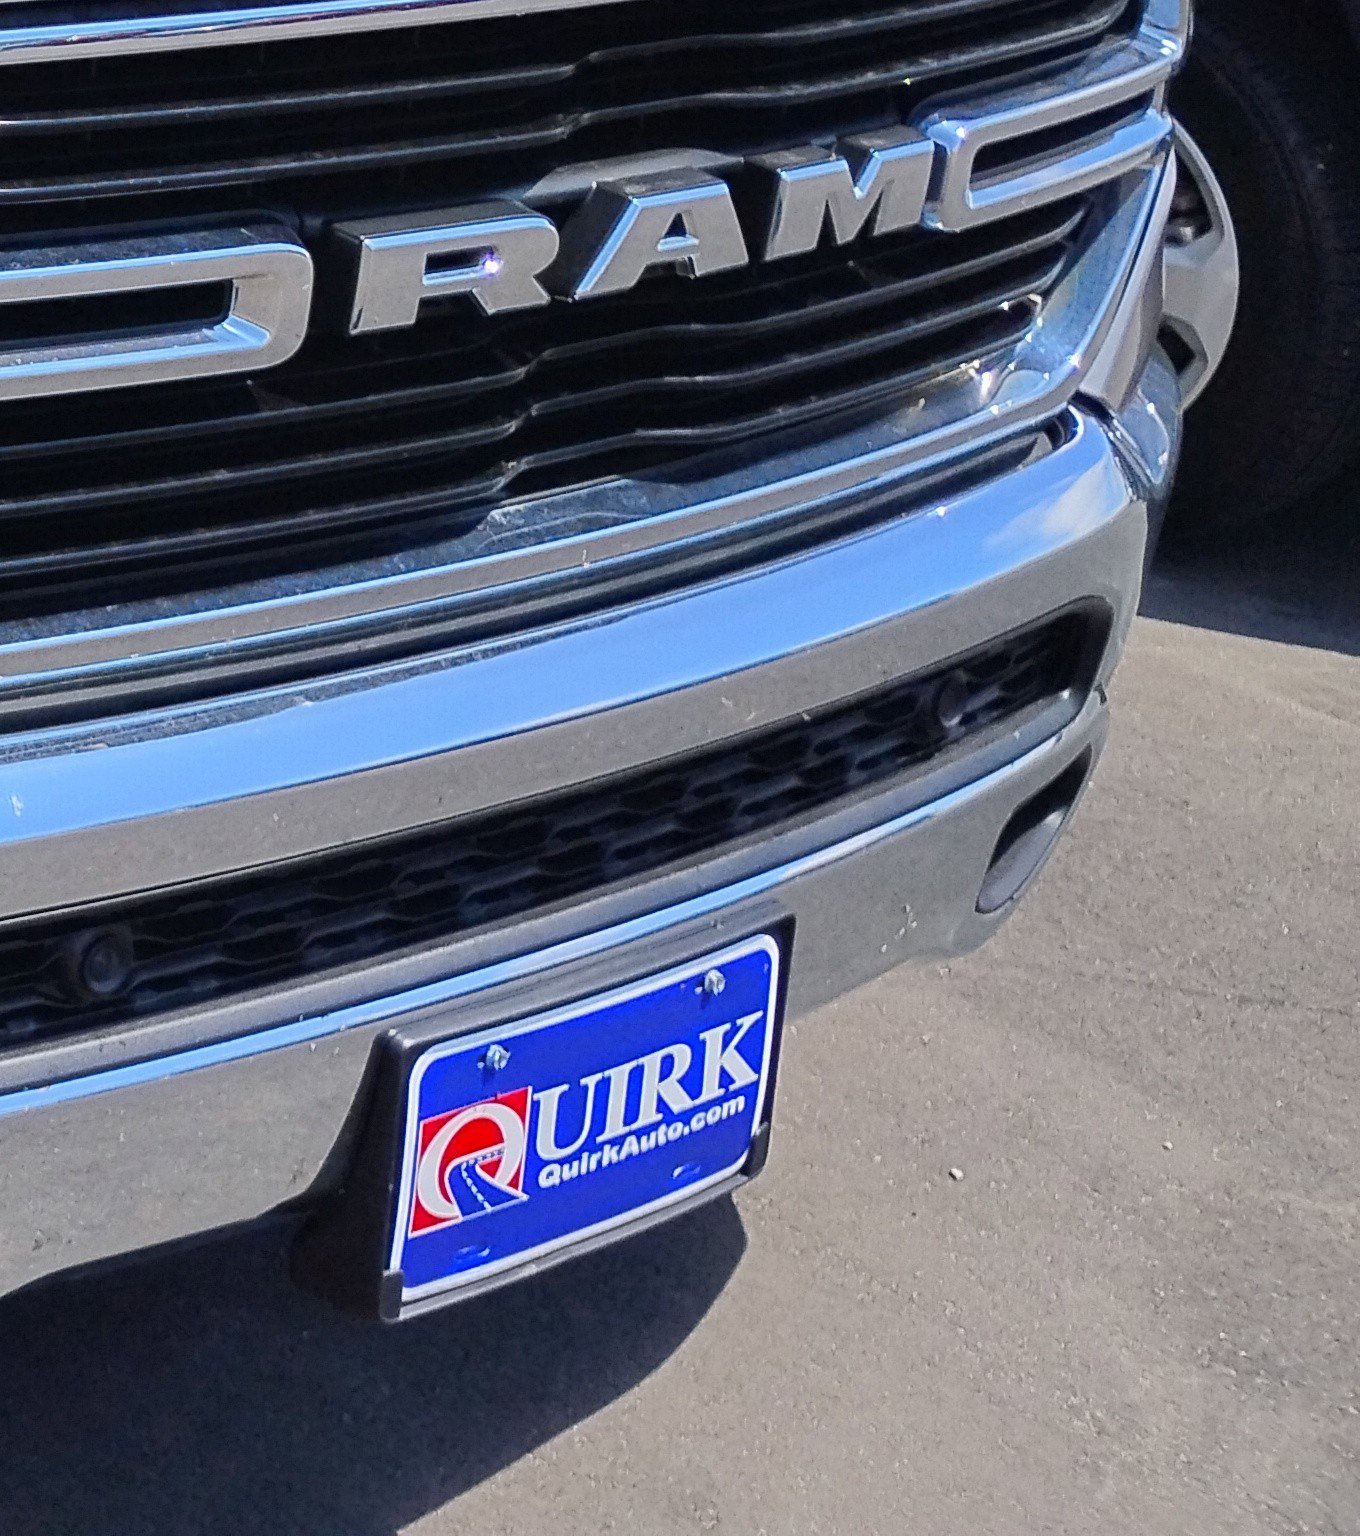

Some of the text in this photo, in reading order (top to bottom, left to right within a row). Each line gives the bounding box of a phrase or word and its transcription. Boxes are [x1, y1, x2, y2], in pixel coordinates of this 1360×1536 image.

[348, 126, 935, 336] RAM
[417, 1010, 764, 1221] QUIRK
[537, 1093, 746, 1190] QuirkAuto.com
